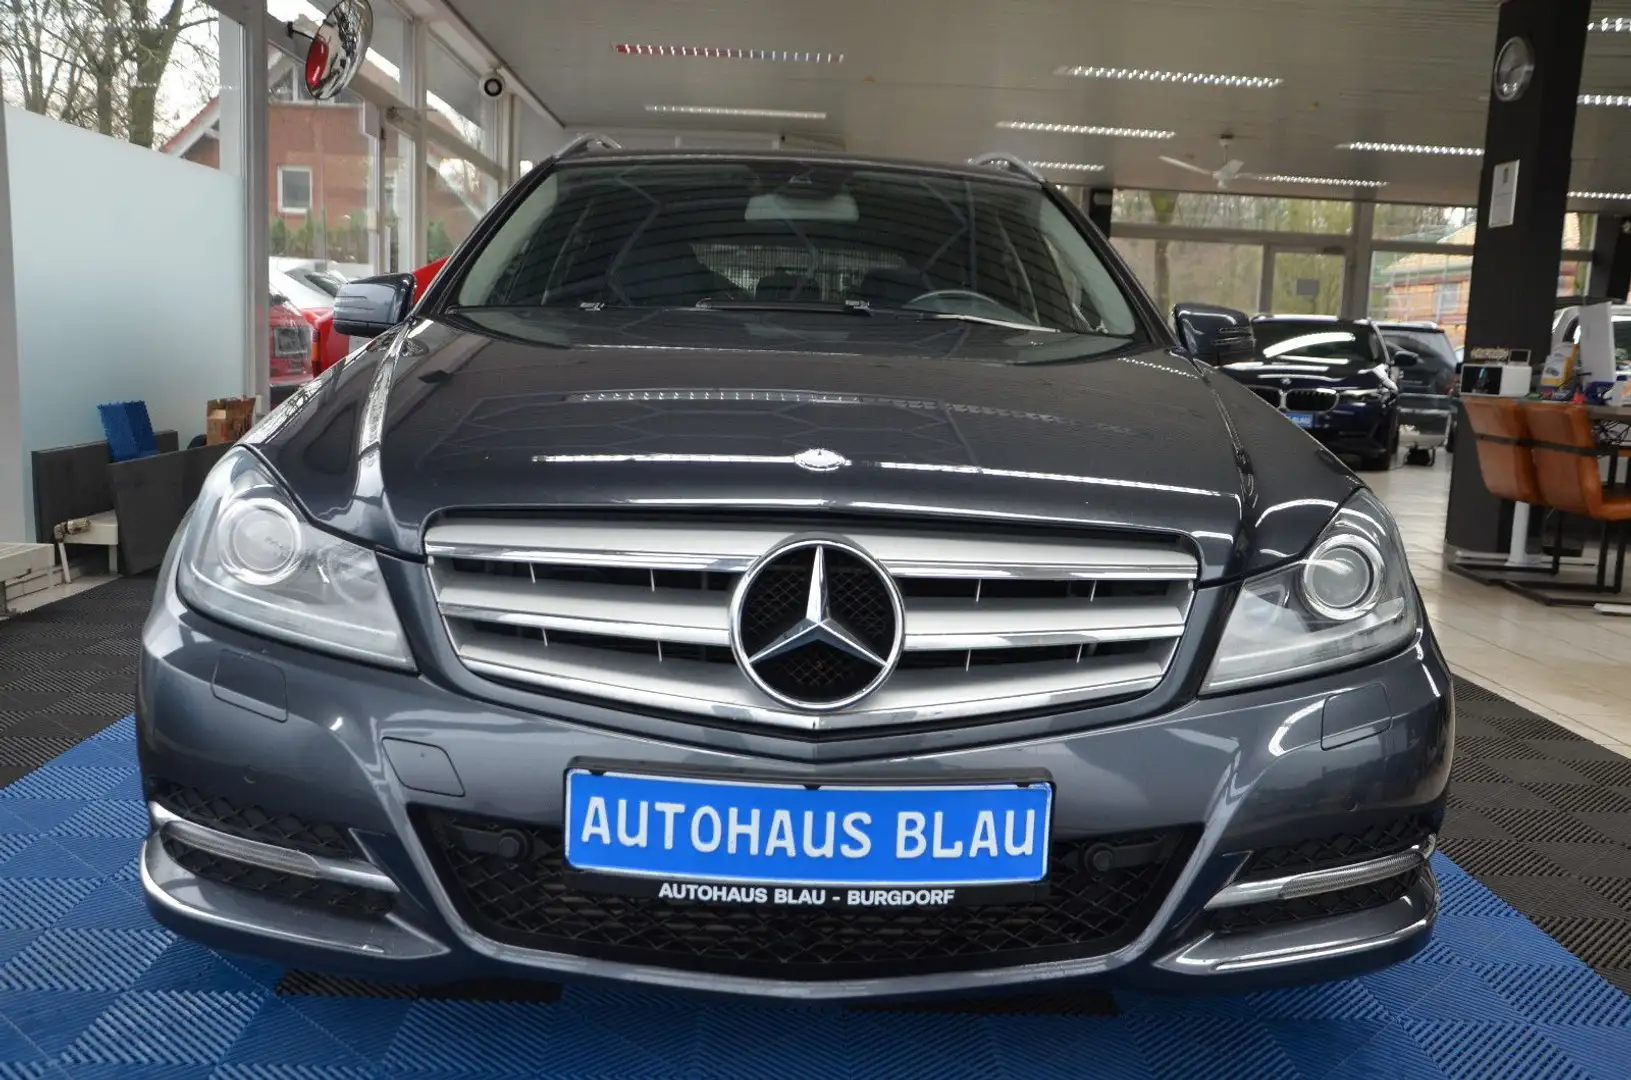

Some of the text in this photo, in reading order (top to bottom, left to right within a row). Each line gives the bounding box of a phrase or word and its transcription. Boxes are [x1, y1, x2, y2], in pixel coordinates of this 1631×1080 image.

[581, 796, 1036, 859] AUTOHAUS BLAU
[658, 881, 768, 904] AUTOHAUS
[774, 887, 826, 905] BLAU
[847, 888, 956, 907] BURGDORF
